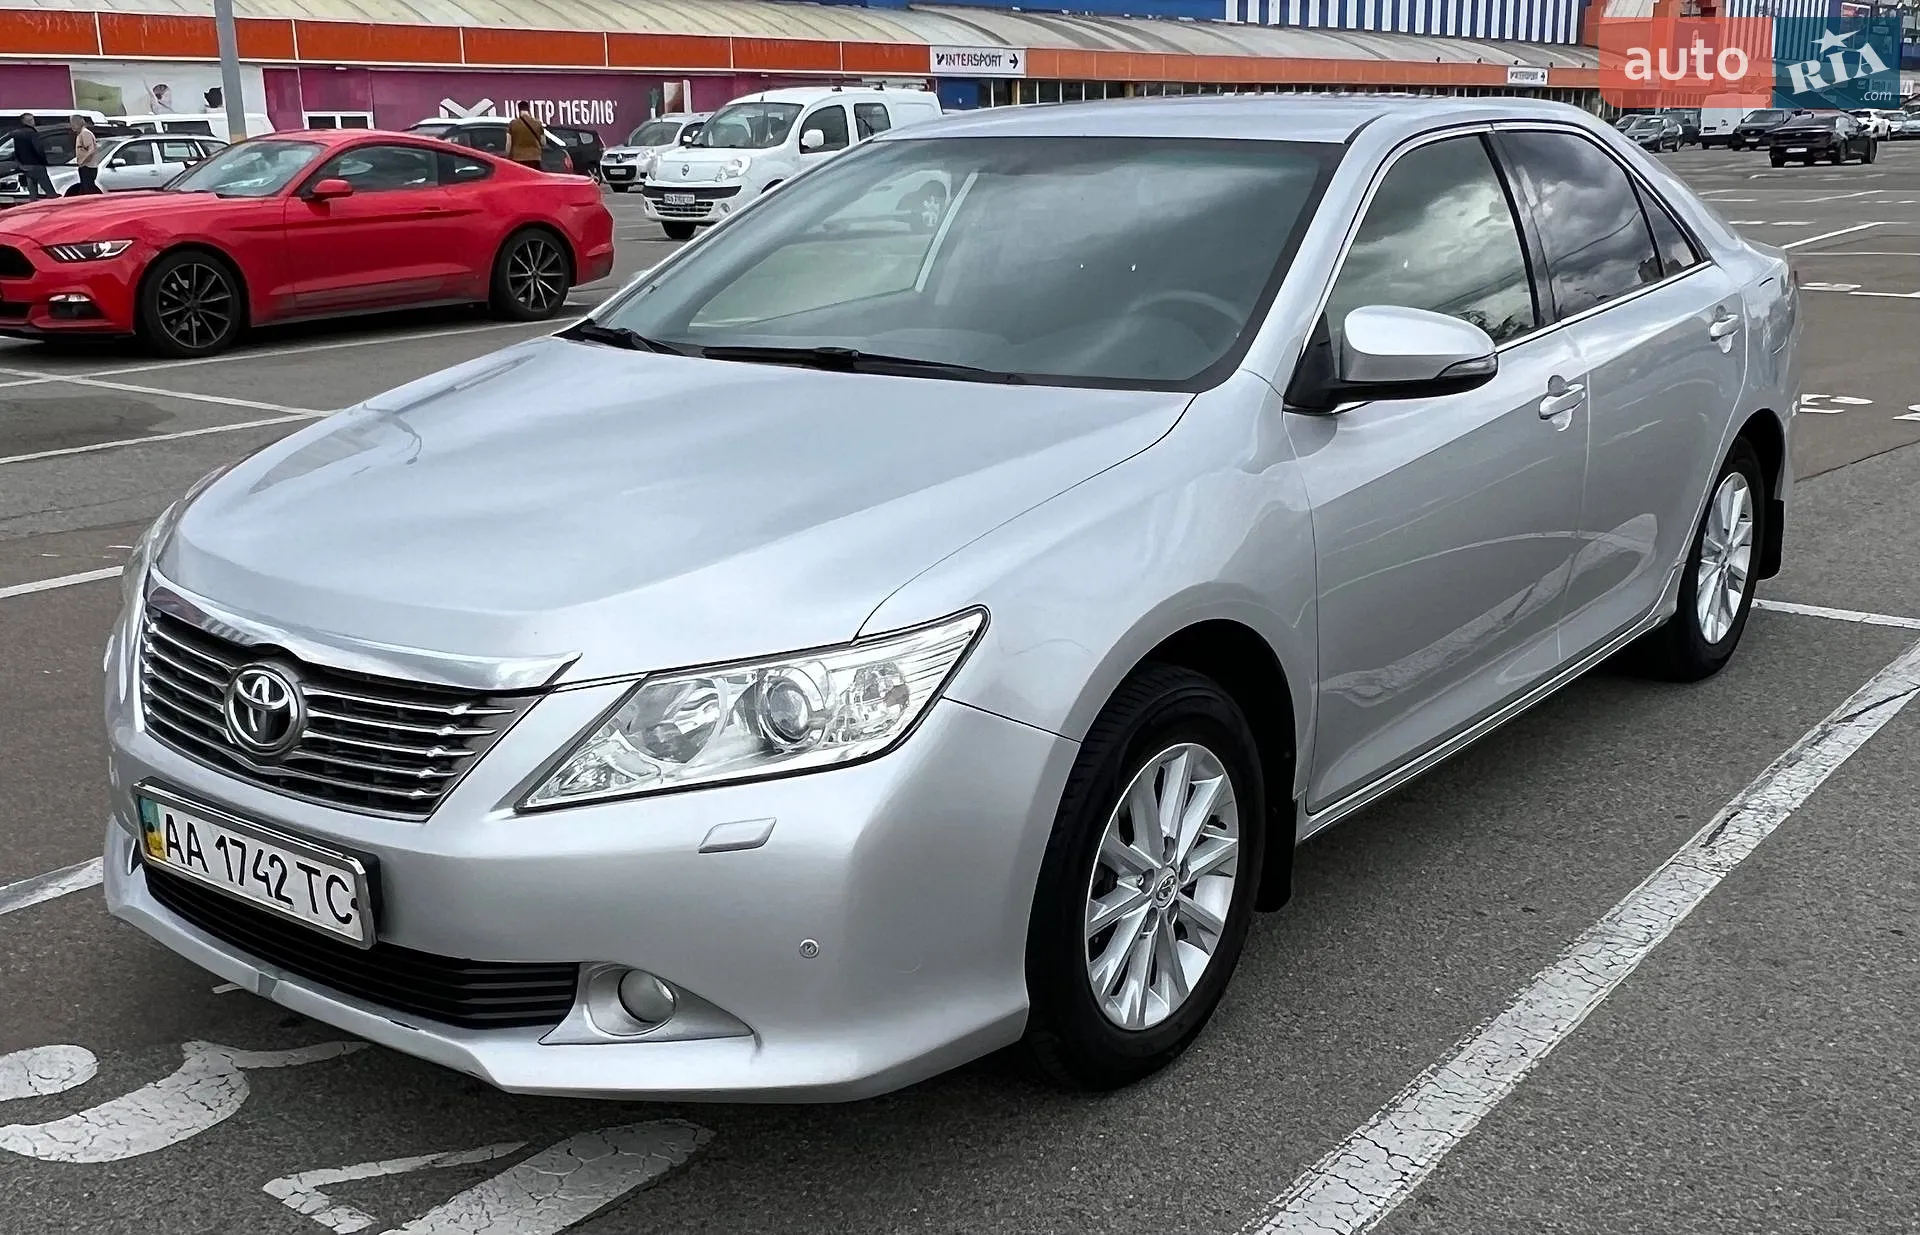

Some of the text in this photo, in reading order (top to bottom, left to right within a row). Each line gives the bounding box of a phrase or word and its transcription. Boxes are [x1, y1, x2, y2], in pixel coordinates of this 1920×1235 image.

[945, 53, 1002, 68] INTERSPORT
[165, 813, 353, 925] AA 1742 TC
